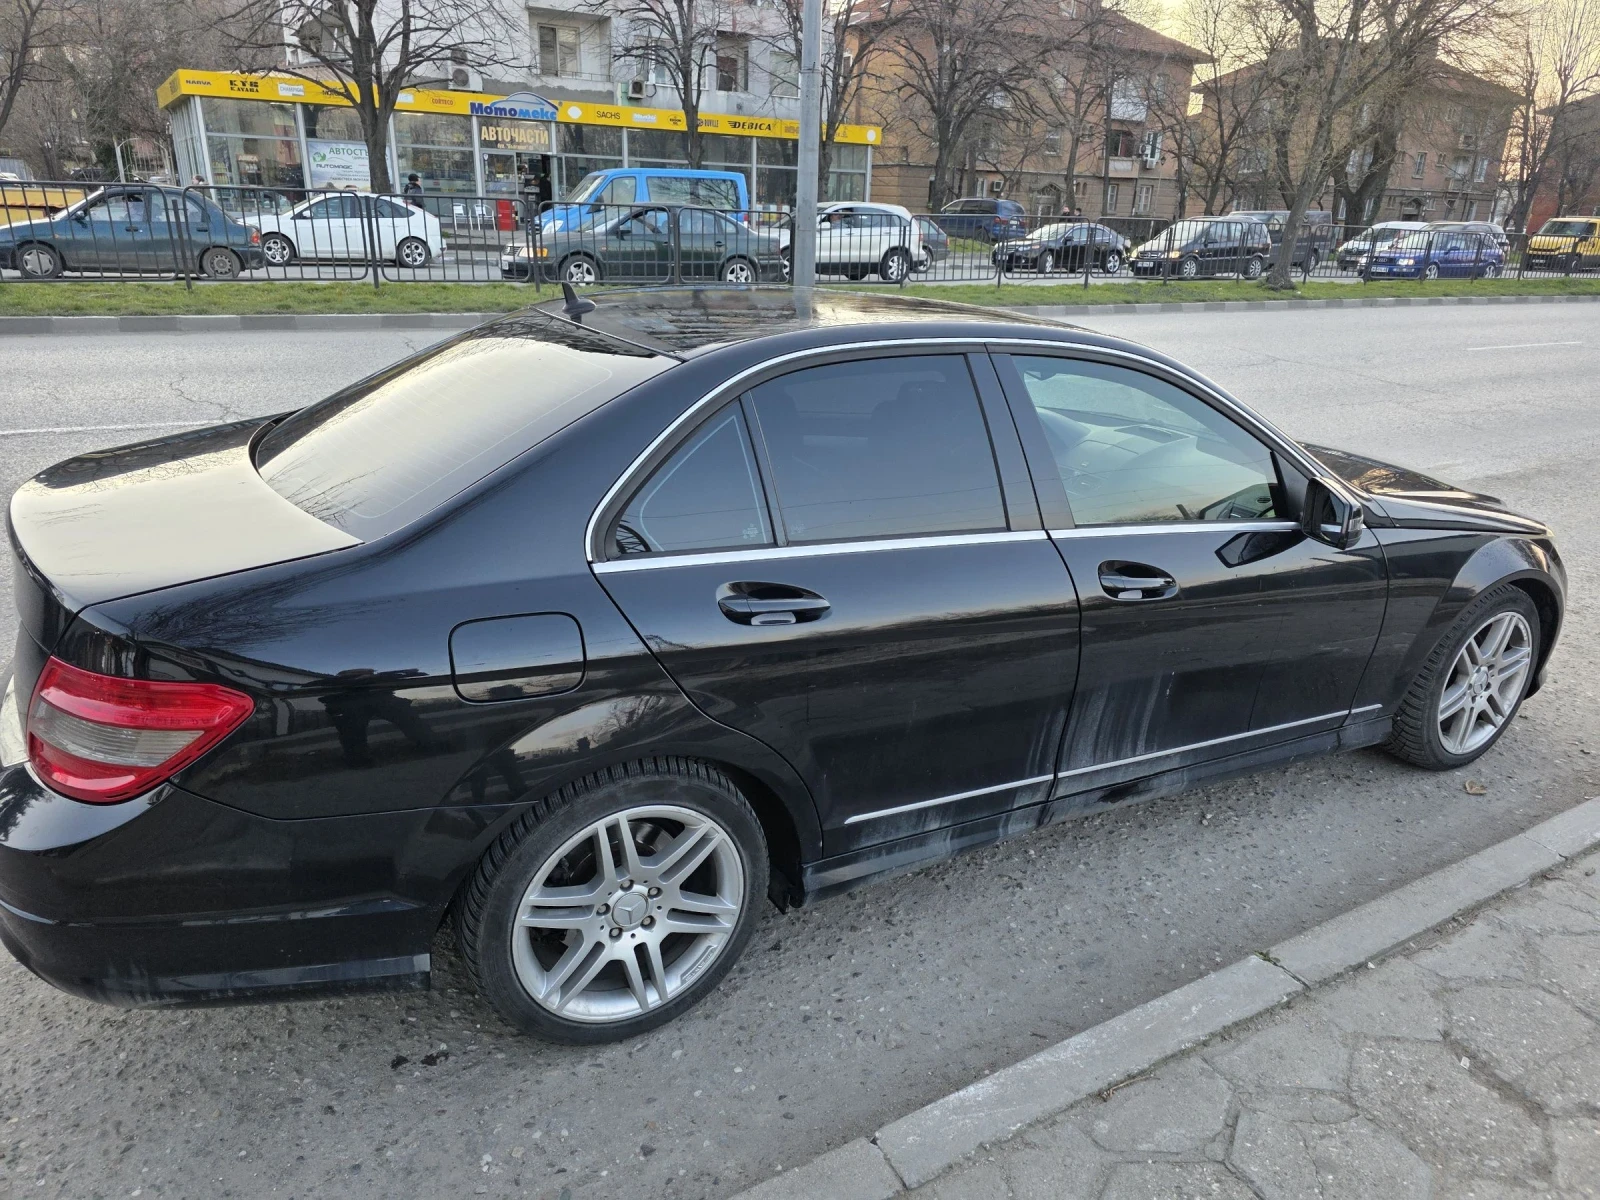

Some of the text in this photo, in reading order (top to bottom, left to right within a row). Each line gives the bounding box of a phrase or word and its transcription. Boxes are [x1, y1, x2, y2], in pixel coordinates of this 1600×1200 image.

[229, 79, 259, 87] KYB
[596, 111, 620, 119] SACHS
[481, 126, 549, 145] АВТОЧАСТИ
